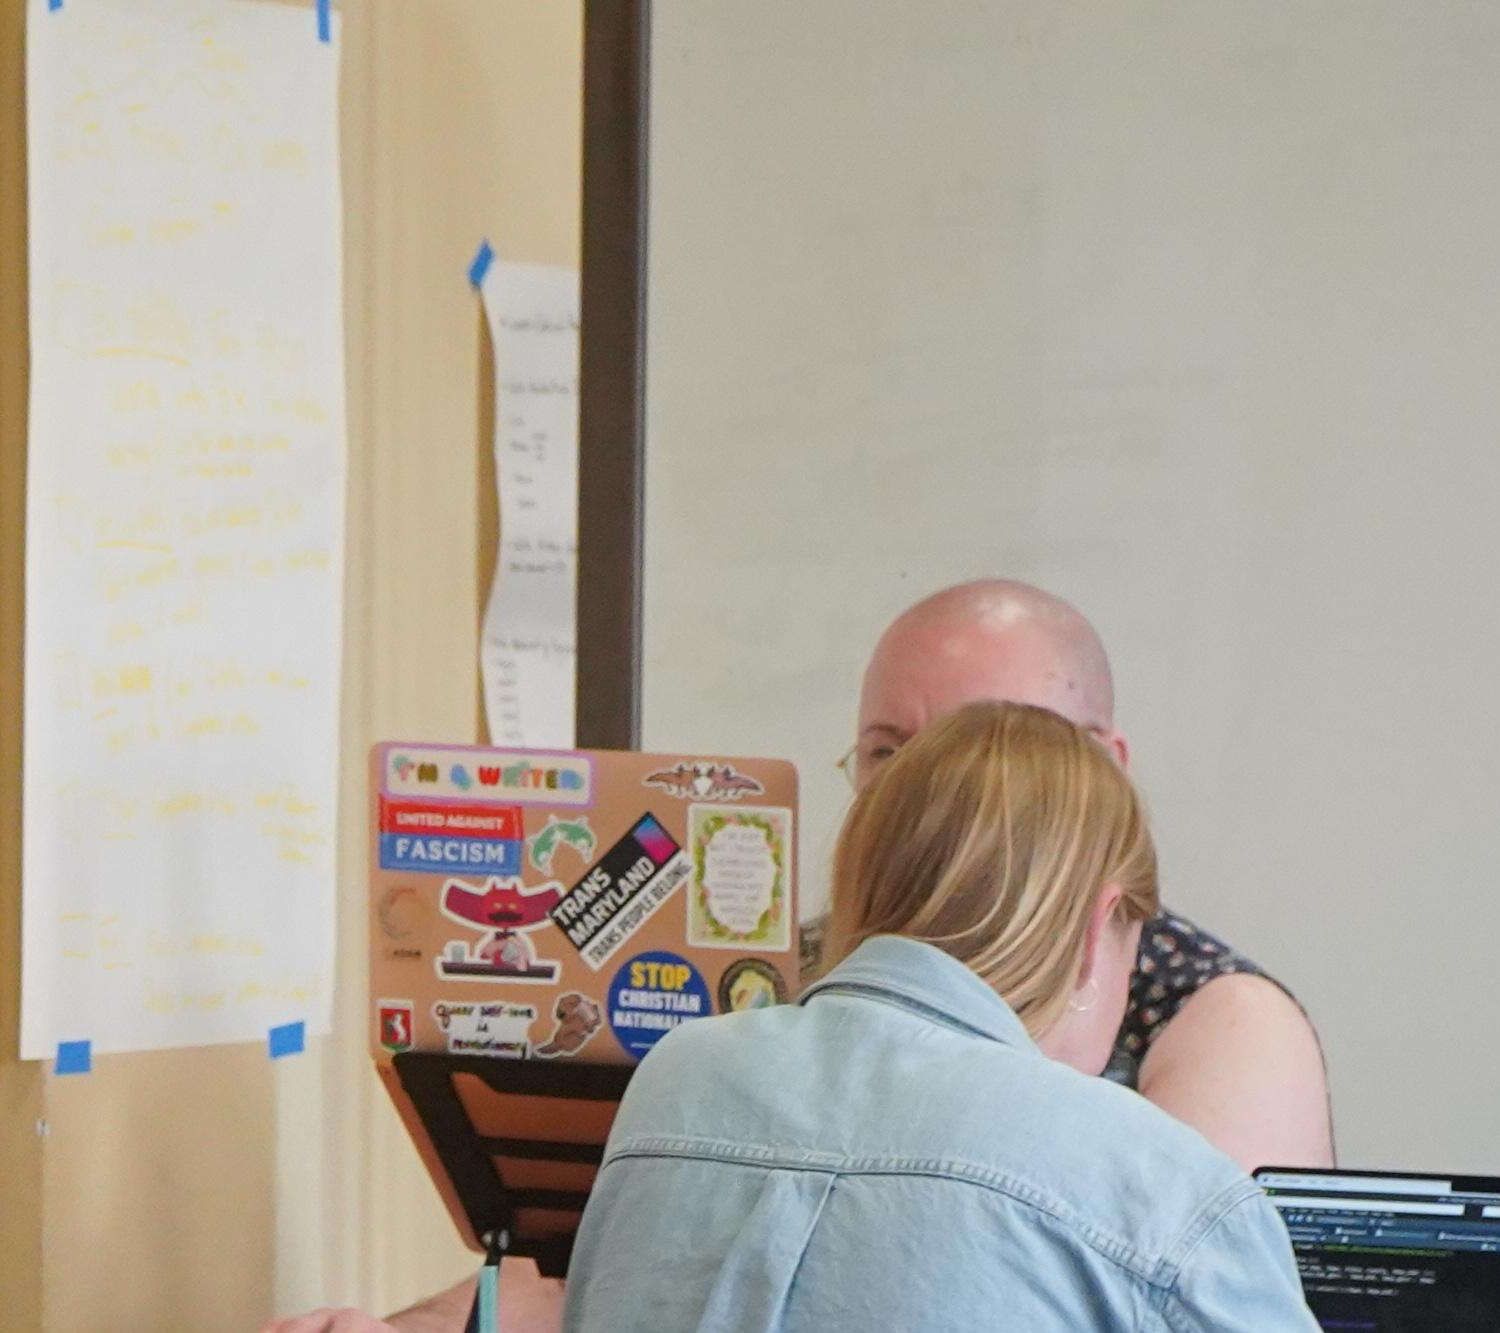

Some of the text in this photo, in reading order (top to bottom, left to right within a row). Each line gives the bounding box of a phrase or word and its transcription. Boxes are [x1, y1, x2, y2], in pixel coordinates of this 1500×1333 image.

[396, 811, 505, 831] UNITED AGAINST
[395, 838, 506, 864] FASCISM
[552, 867, 611, 925] TRANS
[567, 856, 656, 947] MARYLAND
[588, 928, 624, 963] TRANS
[630, 961, 692, 991] STOP
[618, 988, 702, 1013] CHRISTIAN
